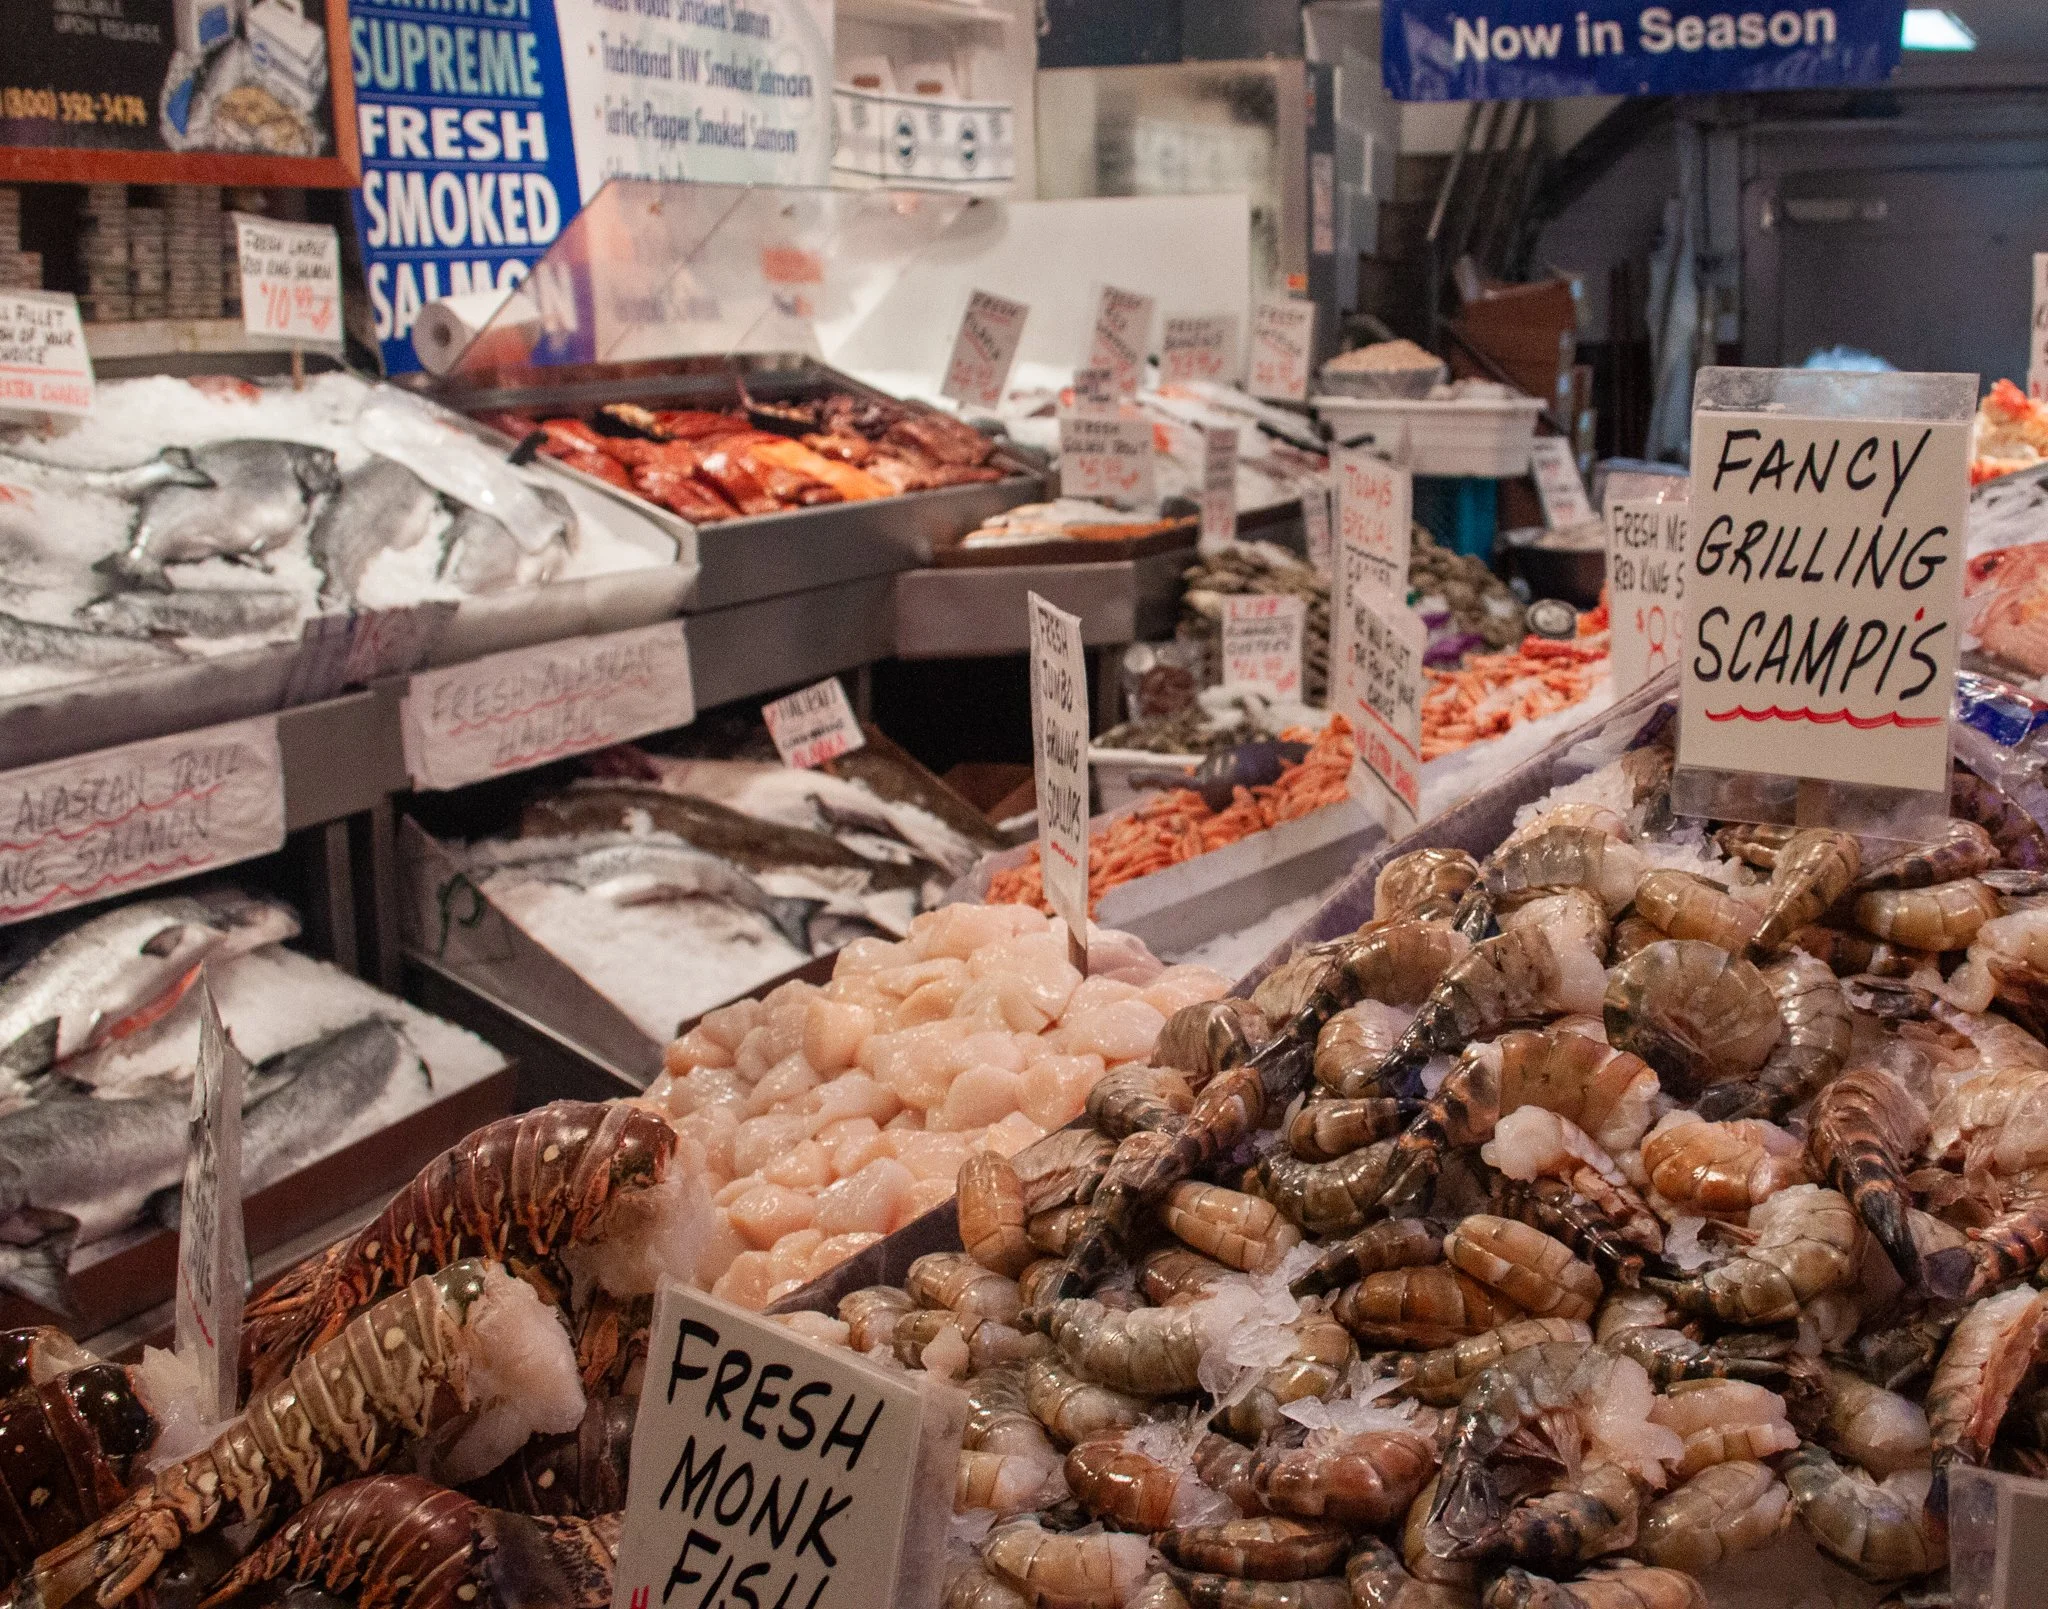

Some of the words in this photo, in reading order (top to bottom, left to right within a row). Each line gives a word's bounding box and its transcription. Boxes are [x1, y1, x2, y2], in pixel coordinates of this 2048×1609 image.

[351, 18, 544, 97] SUPREME
[599, 30, 672, 79] Traditional
[1452, 16, 1561, 62] Now
[1576, 13, 1624, 56] in
[1639, 5, 1837, 53] Season
[359, 104, 549, 161] FRESH
[750, 114, 798, 152] Salmon
[363, 170, 563, 248] SMOKED
[1712, 428, 1933, 517] FANCY
[1614, 504, 1659, 549] FRESH
[1667, 518, 1687, 553] ME
[1695, 515, 1949, 592] GRILLING
[1614, 553, 1638, 594] RED
[1642, 555, 1671, 599] KING
[1038, 607, 1069, 656] FRESH
[430, 679, 528, 724] FRESH
[13, 764, 147, 836] ALASKAN
[0, 852, 47, 898] NG
[75, 792, 210, 882] SALMON
[667, 1318, 884, 1471] FRESH
[659, 1435, 853, 1567] MONK
